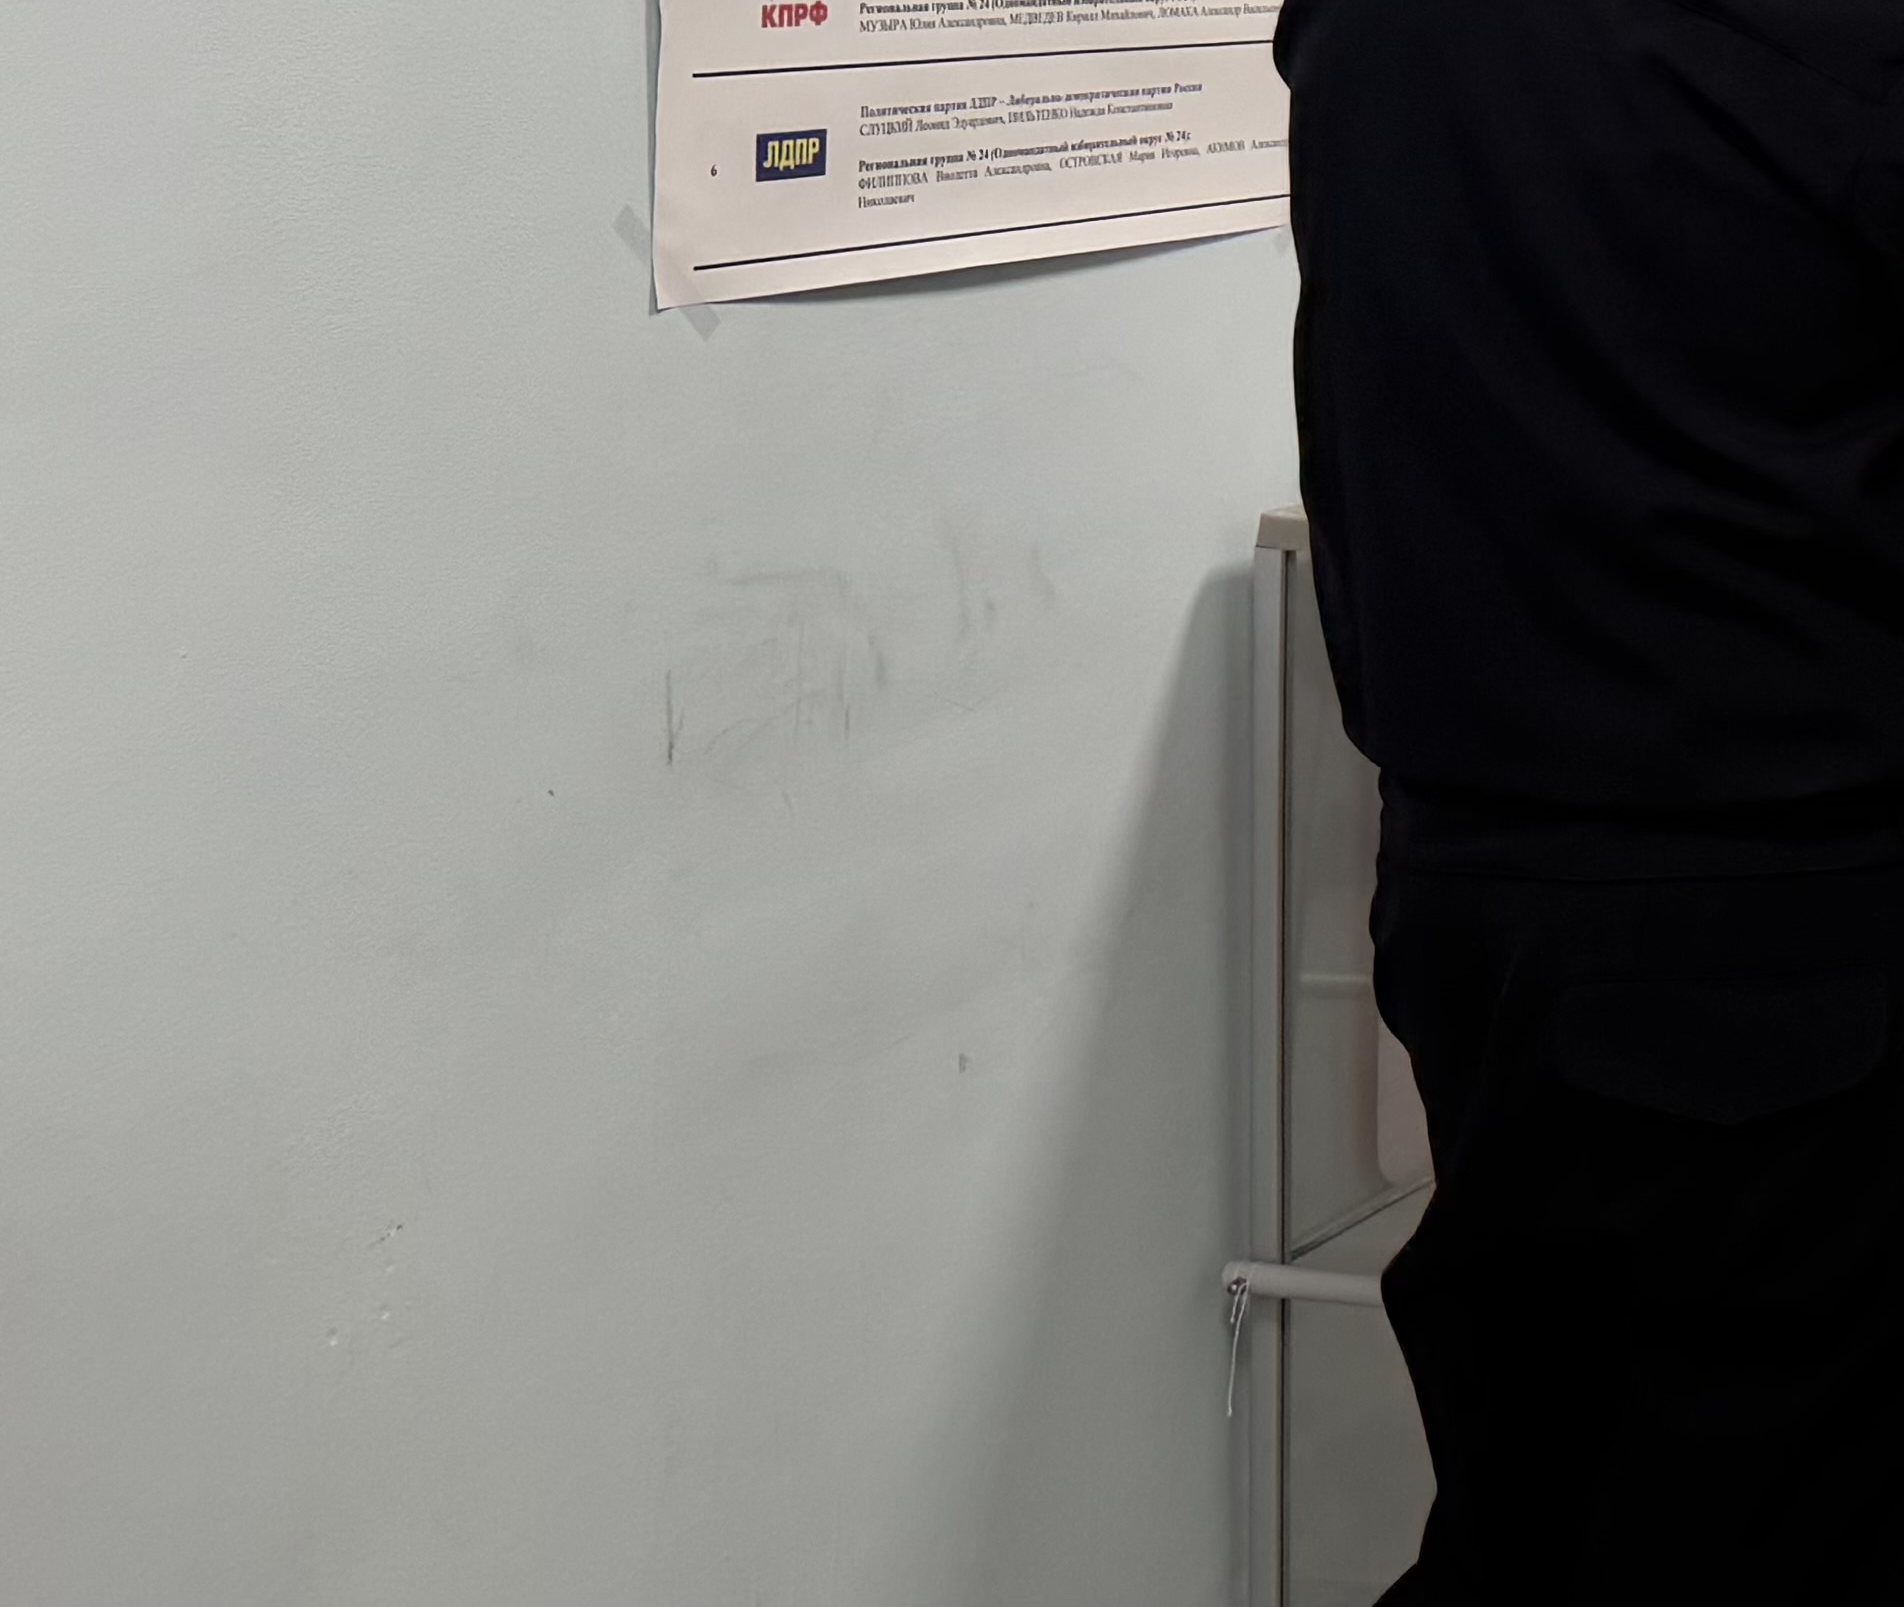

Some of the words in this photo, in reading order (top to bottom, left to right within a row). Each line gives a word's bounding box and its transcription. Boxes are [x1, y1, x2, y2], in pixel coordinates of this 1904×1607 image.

[761, 0, 828, 28] КПРФ
[763, 137, 820, 171] ЛДПР
[977, 147, 989, 161] 24
[710, 164, 718, 177] 6
